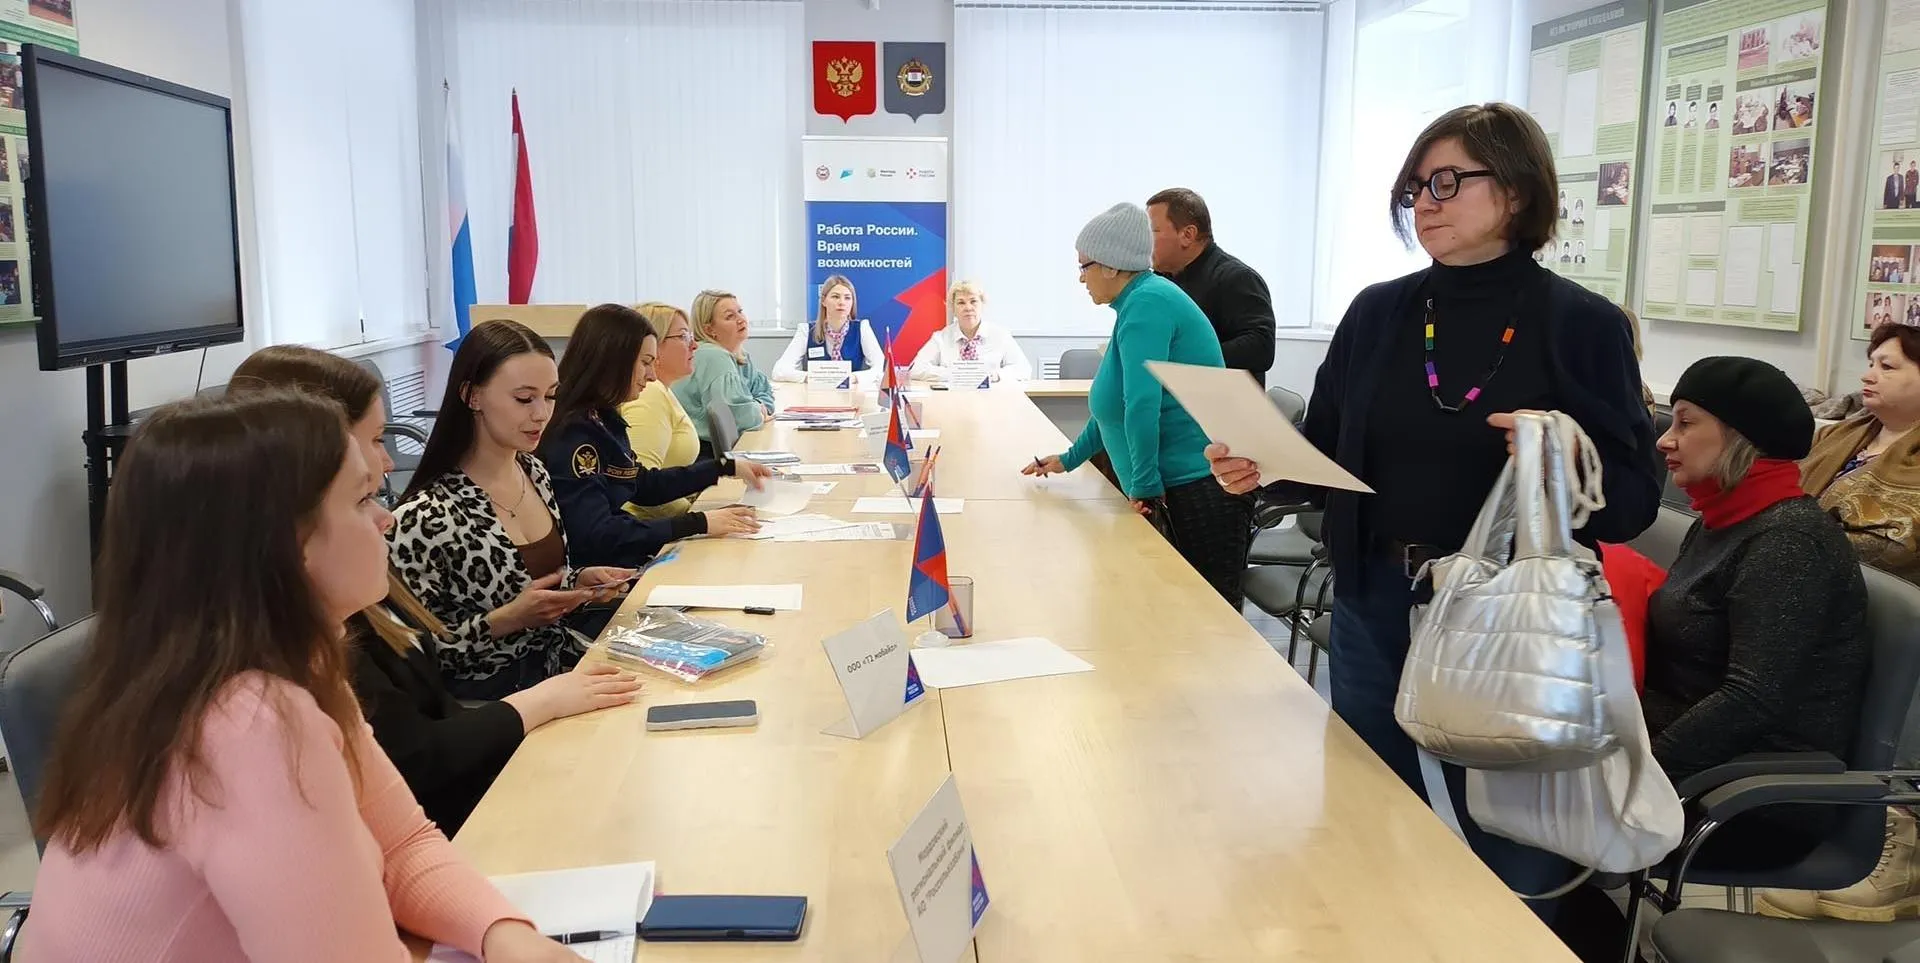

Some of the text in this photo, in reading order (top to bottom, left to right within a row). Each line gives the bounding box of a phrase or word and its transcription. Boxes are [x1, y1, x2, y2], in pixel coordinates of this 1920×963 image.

[816, 223, 919, 236] Работа России.
[817, 240, 860, 254] Время
[817, 256, 913, 268] возможностей
[846, 660, 862, 673] ООО
